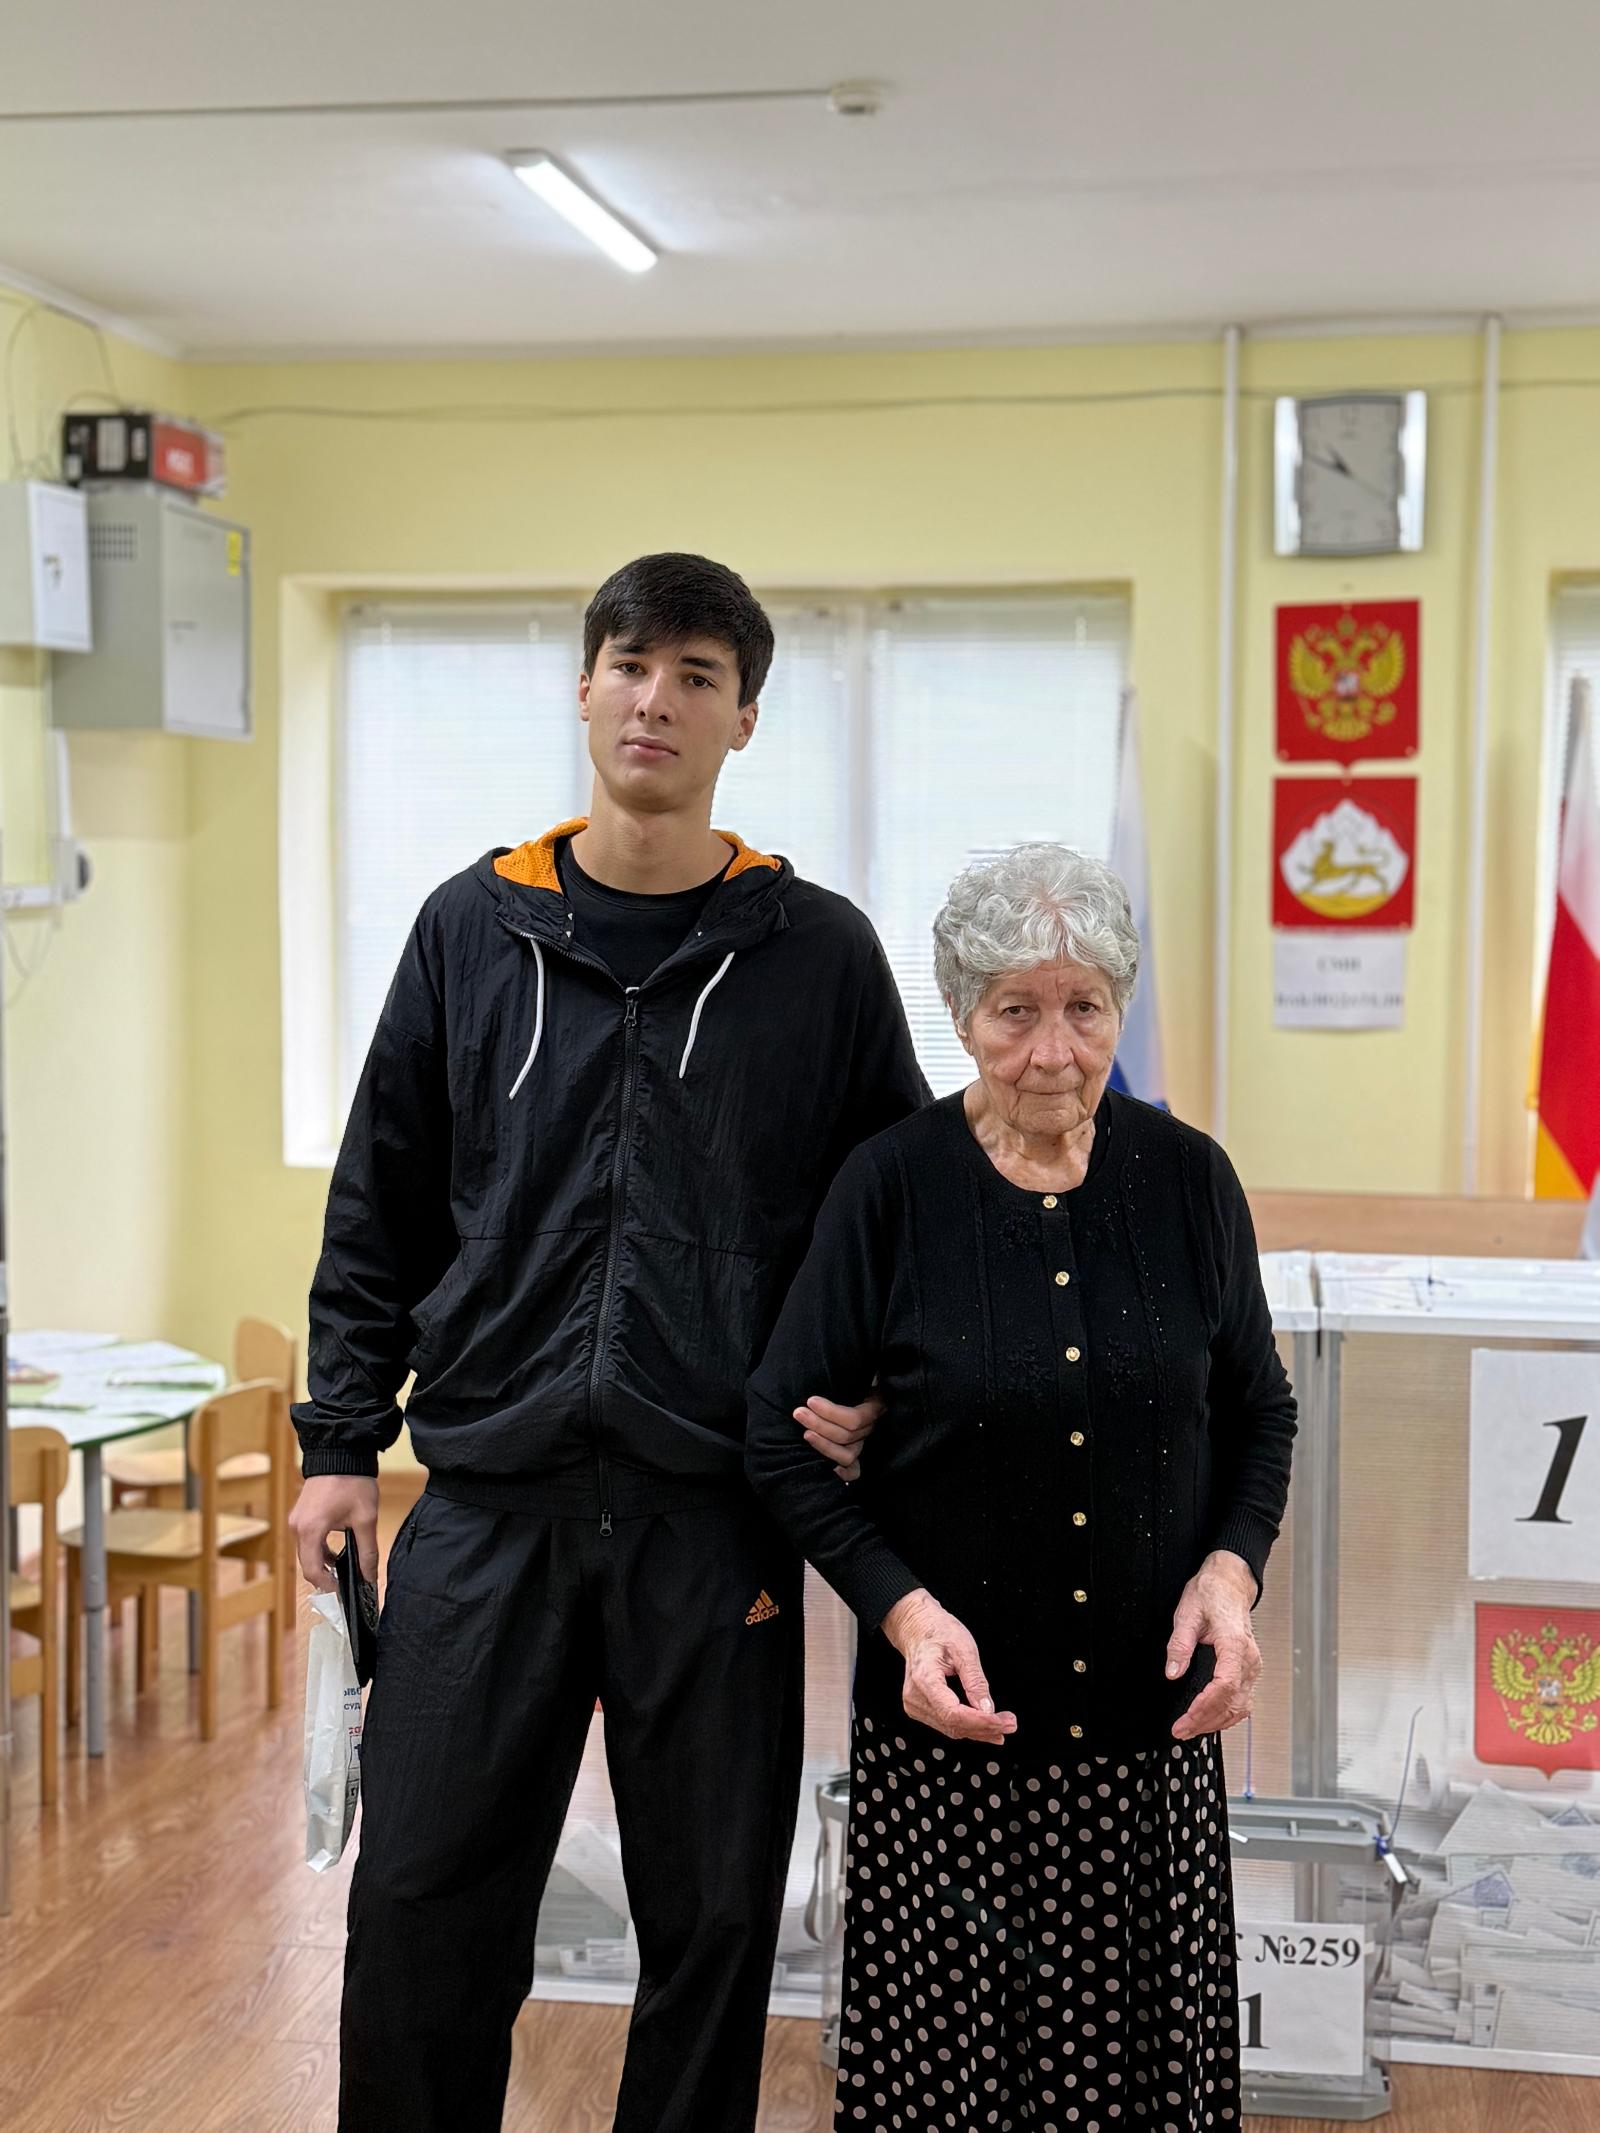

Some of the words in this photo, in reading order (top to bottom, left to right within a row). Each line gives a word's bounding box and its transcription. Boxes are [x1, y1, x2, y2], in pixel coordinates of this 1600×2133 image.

[1514, 1414, 1588, 1525] 1
[745, 1605, 779, 1625] adidas
[1255, 1933, 1361, 1968] №259
[1238, 1992, 1271, 2050] 1
